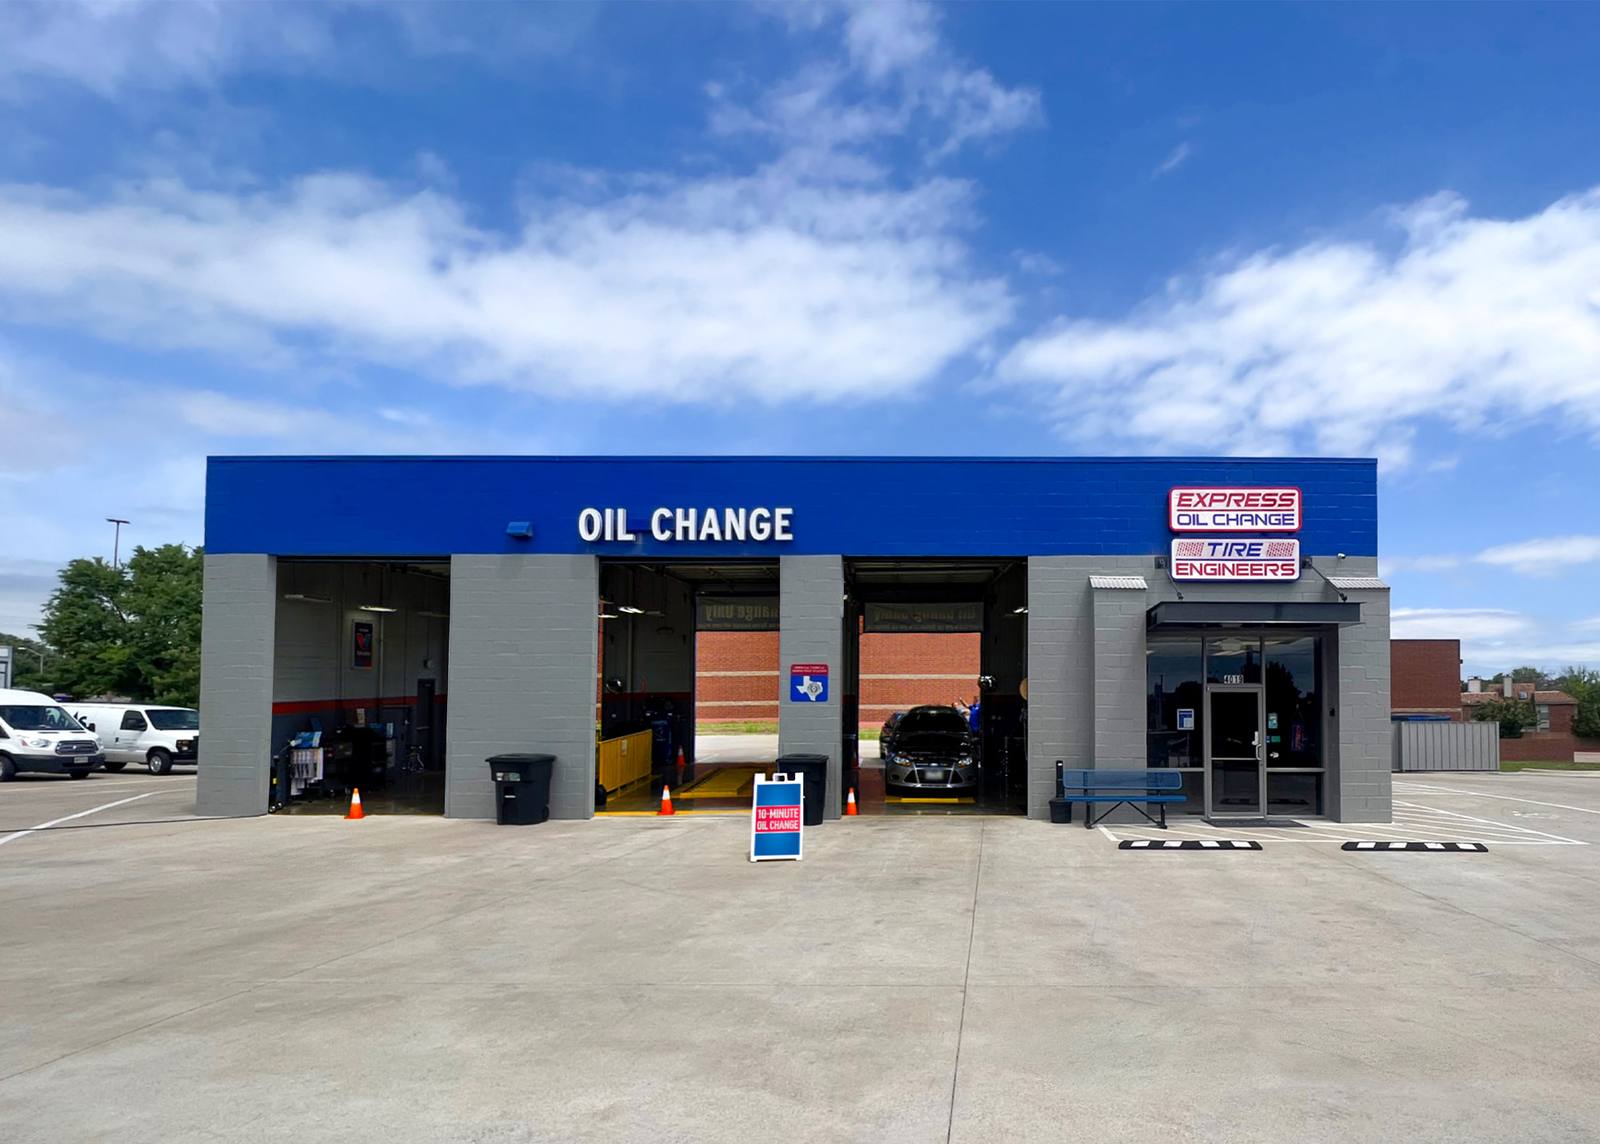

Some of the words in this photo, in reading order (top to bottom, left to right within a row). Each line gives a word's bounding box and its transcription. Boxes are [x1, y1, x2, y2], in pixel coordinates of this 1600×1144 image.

[1176, 492, 1296, 508] EXPRESS
[578, 508, 636, 541] OIL
[651, 508, 793, 541] CHANGE
[1177, 513, 1208, 526] OIL
[1212, 513, 1295, 526] CHANGE
[1207, 542, 1264, 557] TIRE
[1175, 563, 1296, 576] ENGINEERS
[757, 808, 799, 819] 10-MINUTE
[757, 821, 768, 831] OIL
[769, 820, 799, 830] CHANGE
